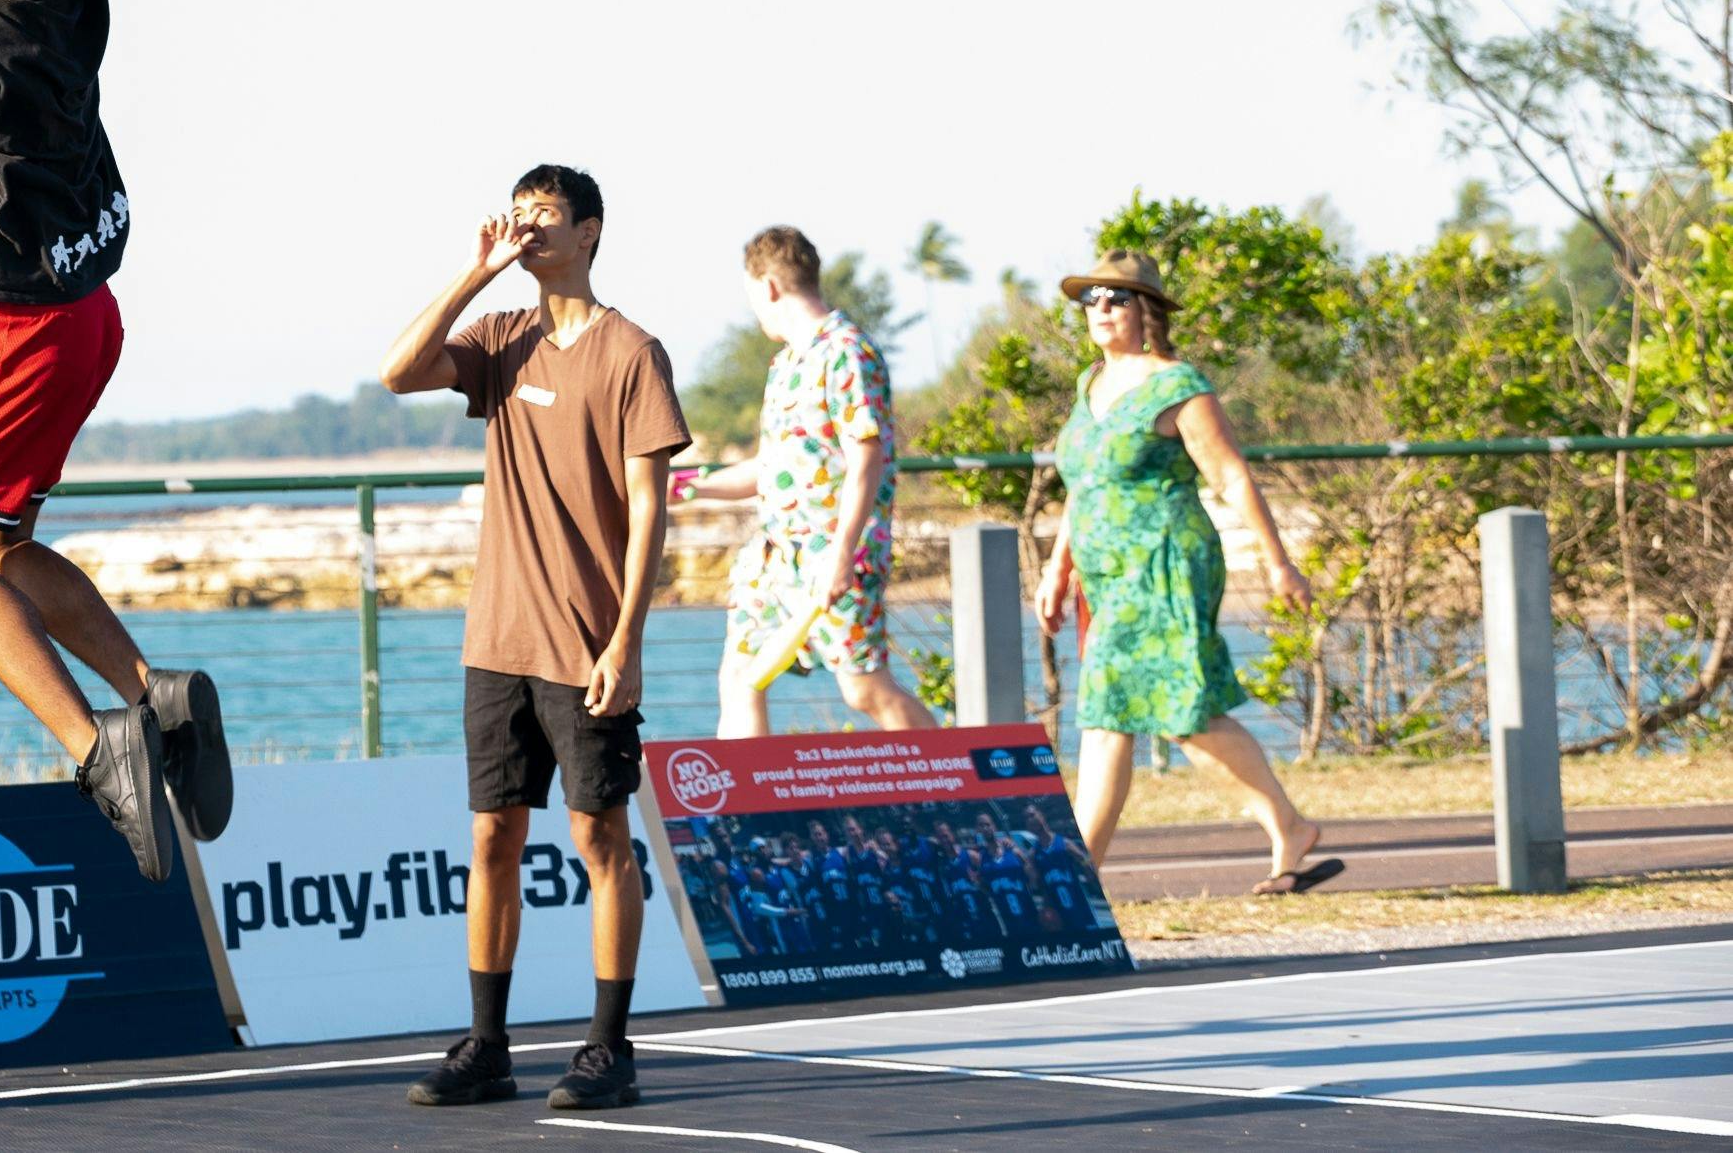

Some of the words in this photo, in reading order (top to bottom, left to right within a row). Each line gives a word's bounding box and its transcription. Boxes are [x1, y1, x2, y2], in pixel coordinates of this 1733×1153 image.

[794, 749, 821, 762] 3x3
[821, 744, 895, 760] Basketball
[910, 745, 921, 756] a
[675, 760, 707, 781] NO
[752, 767, 795, 785] proud
[796, 765, 864, 781] supporter
[866, 762, 881, 775] of
[882, 761, 906, 774] the
[906, 759, 929, 773] NO
[929, 757, 973, 771] MORE
[677, 770, 737, 800] MORE
[773, 786, 791, 798] to
[791, 783, 835, 798] family
[836, 780, 895, 795] violence
[896, 775, 964, 792] campaign
[720, 971, 759, 988] 1800
[759, 969, 788, 985] 899
[788, 967, 817, 983] 855
[822, 959, 926, 978] nomore.org.au
